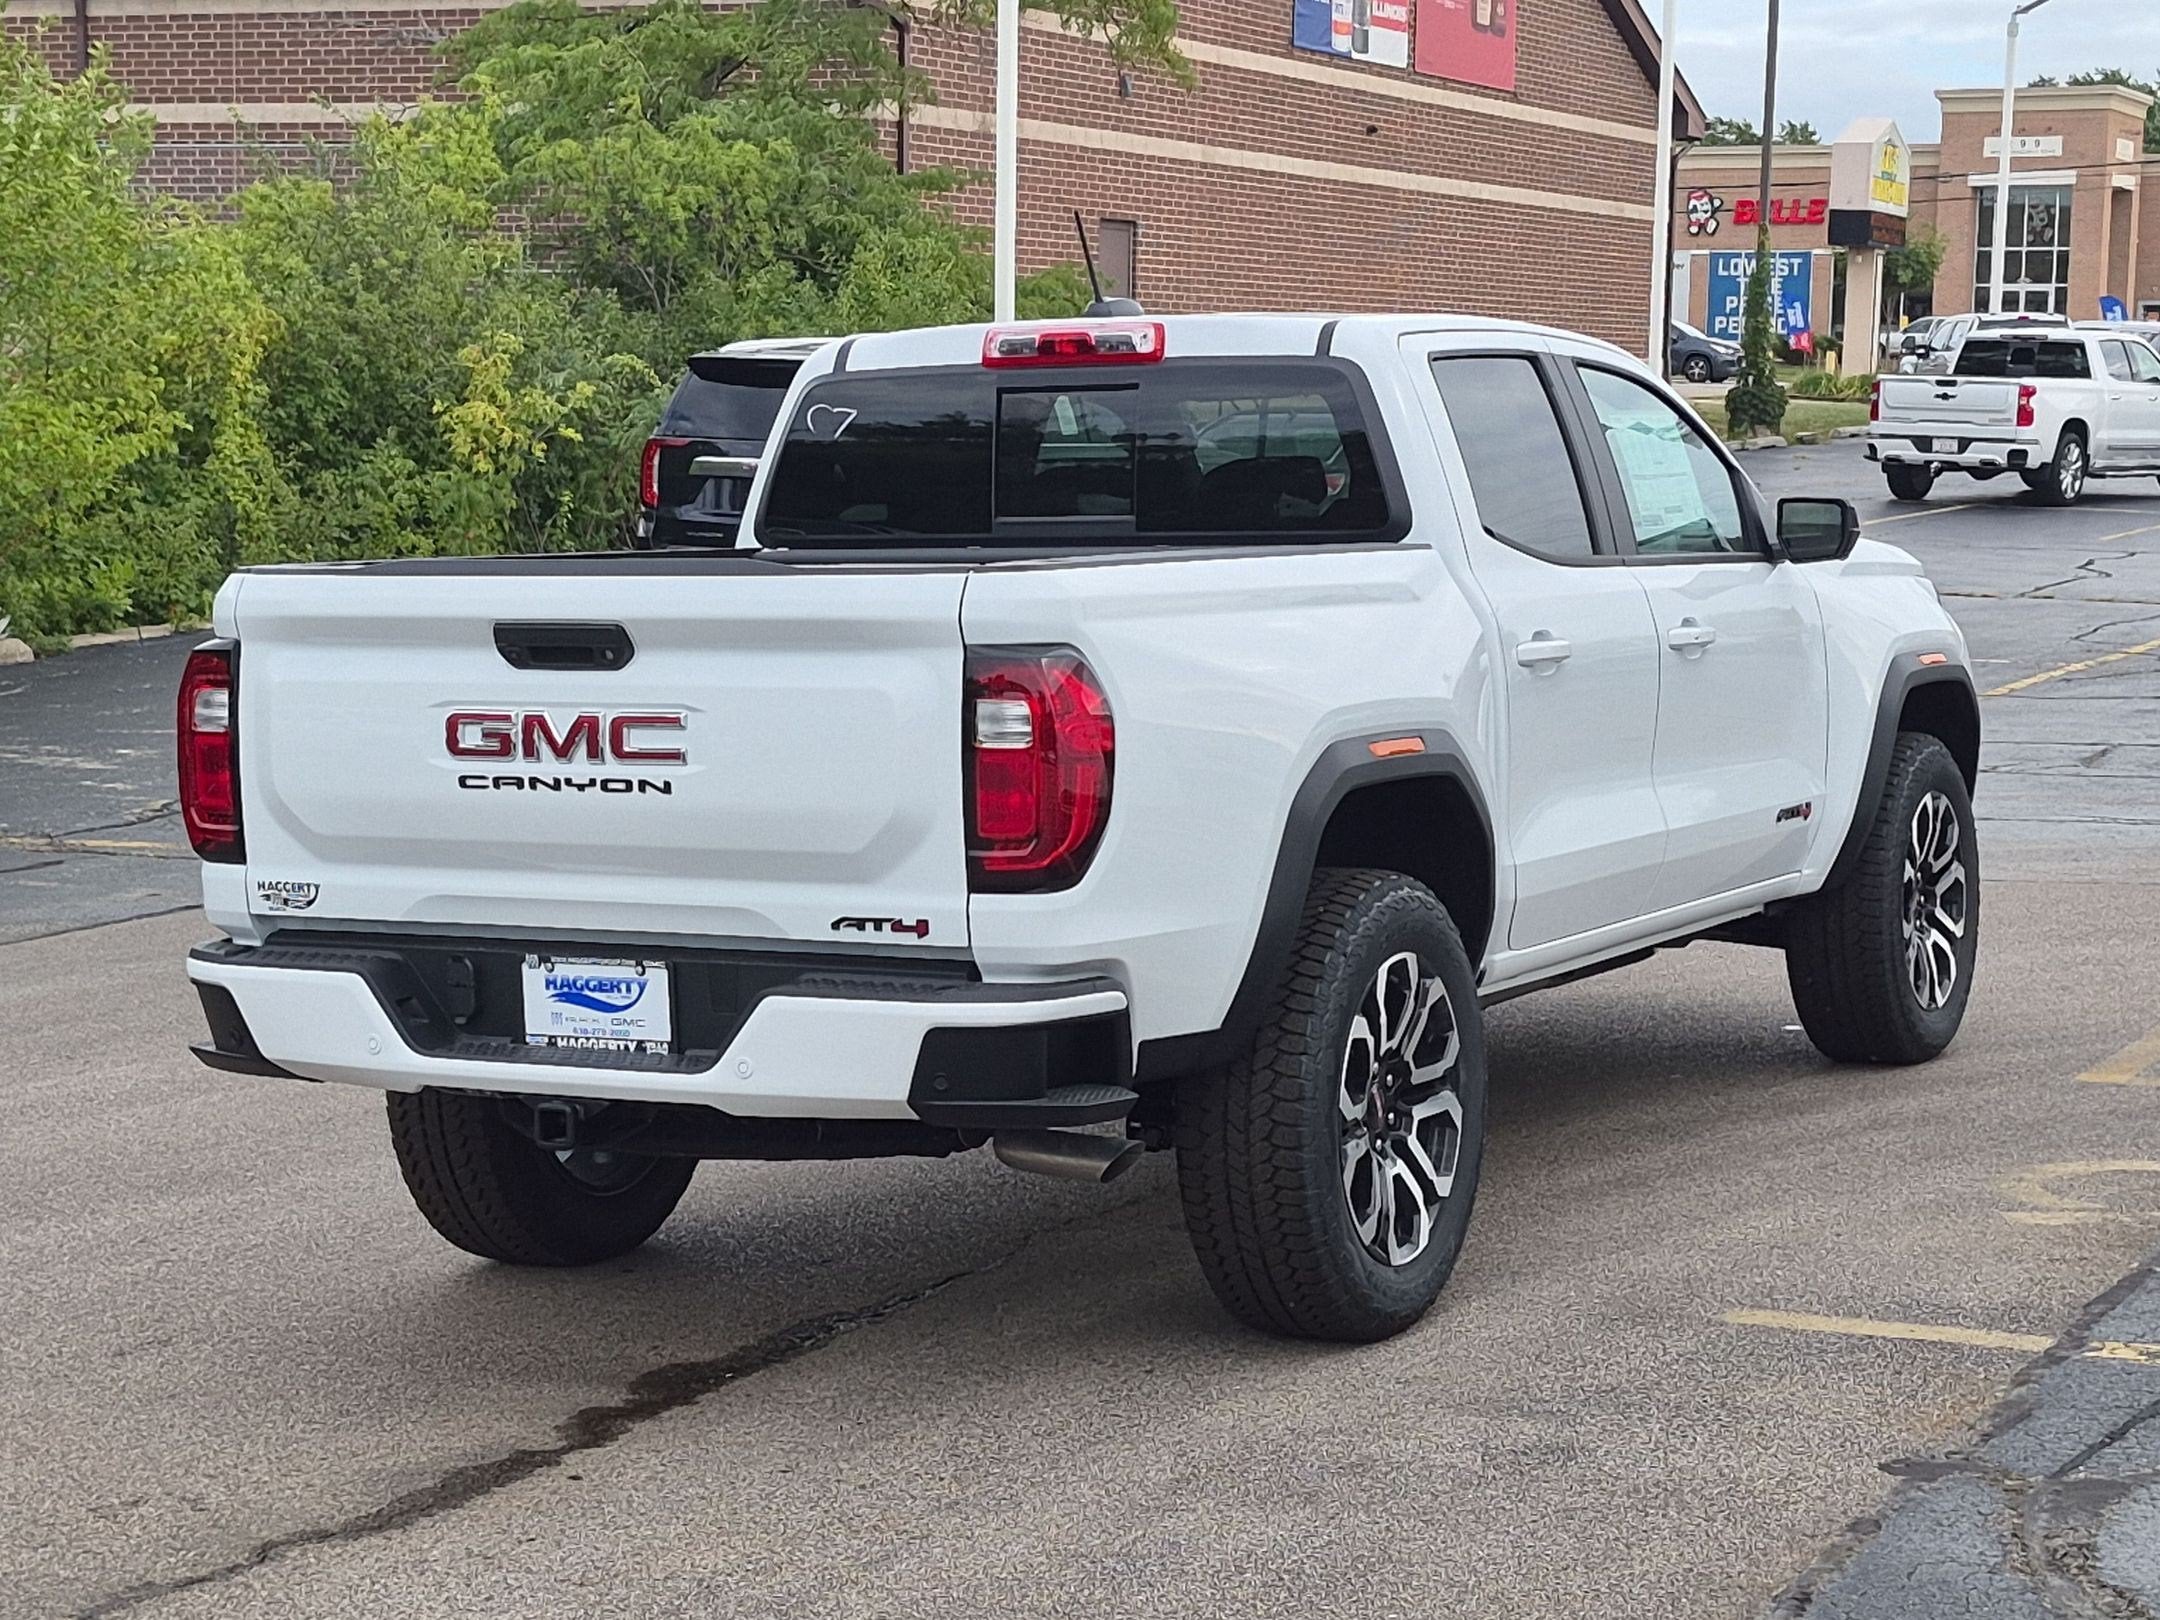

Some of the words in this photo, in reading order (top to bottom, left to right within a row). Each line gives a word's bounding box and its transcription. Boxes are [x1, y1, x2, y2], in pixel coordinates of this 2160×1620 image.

[444, 708, 688, 766] GMC
[458, 775, 673, 795] CANYON
[257, 880, 320, 898] HAGGERTY
[830, 916, 930, 939] AT4
[544, 974, 649, 996] HAGGERTY
[611, 1018, 646, 1027] GMC
